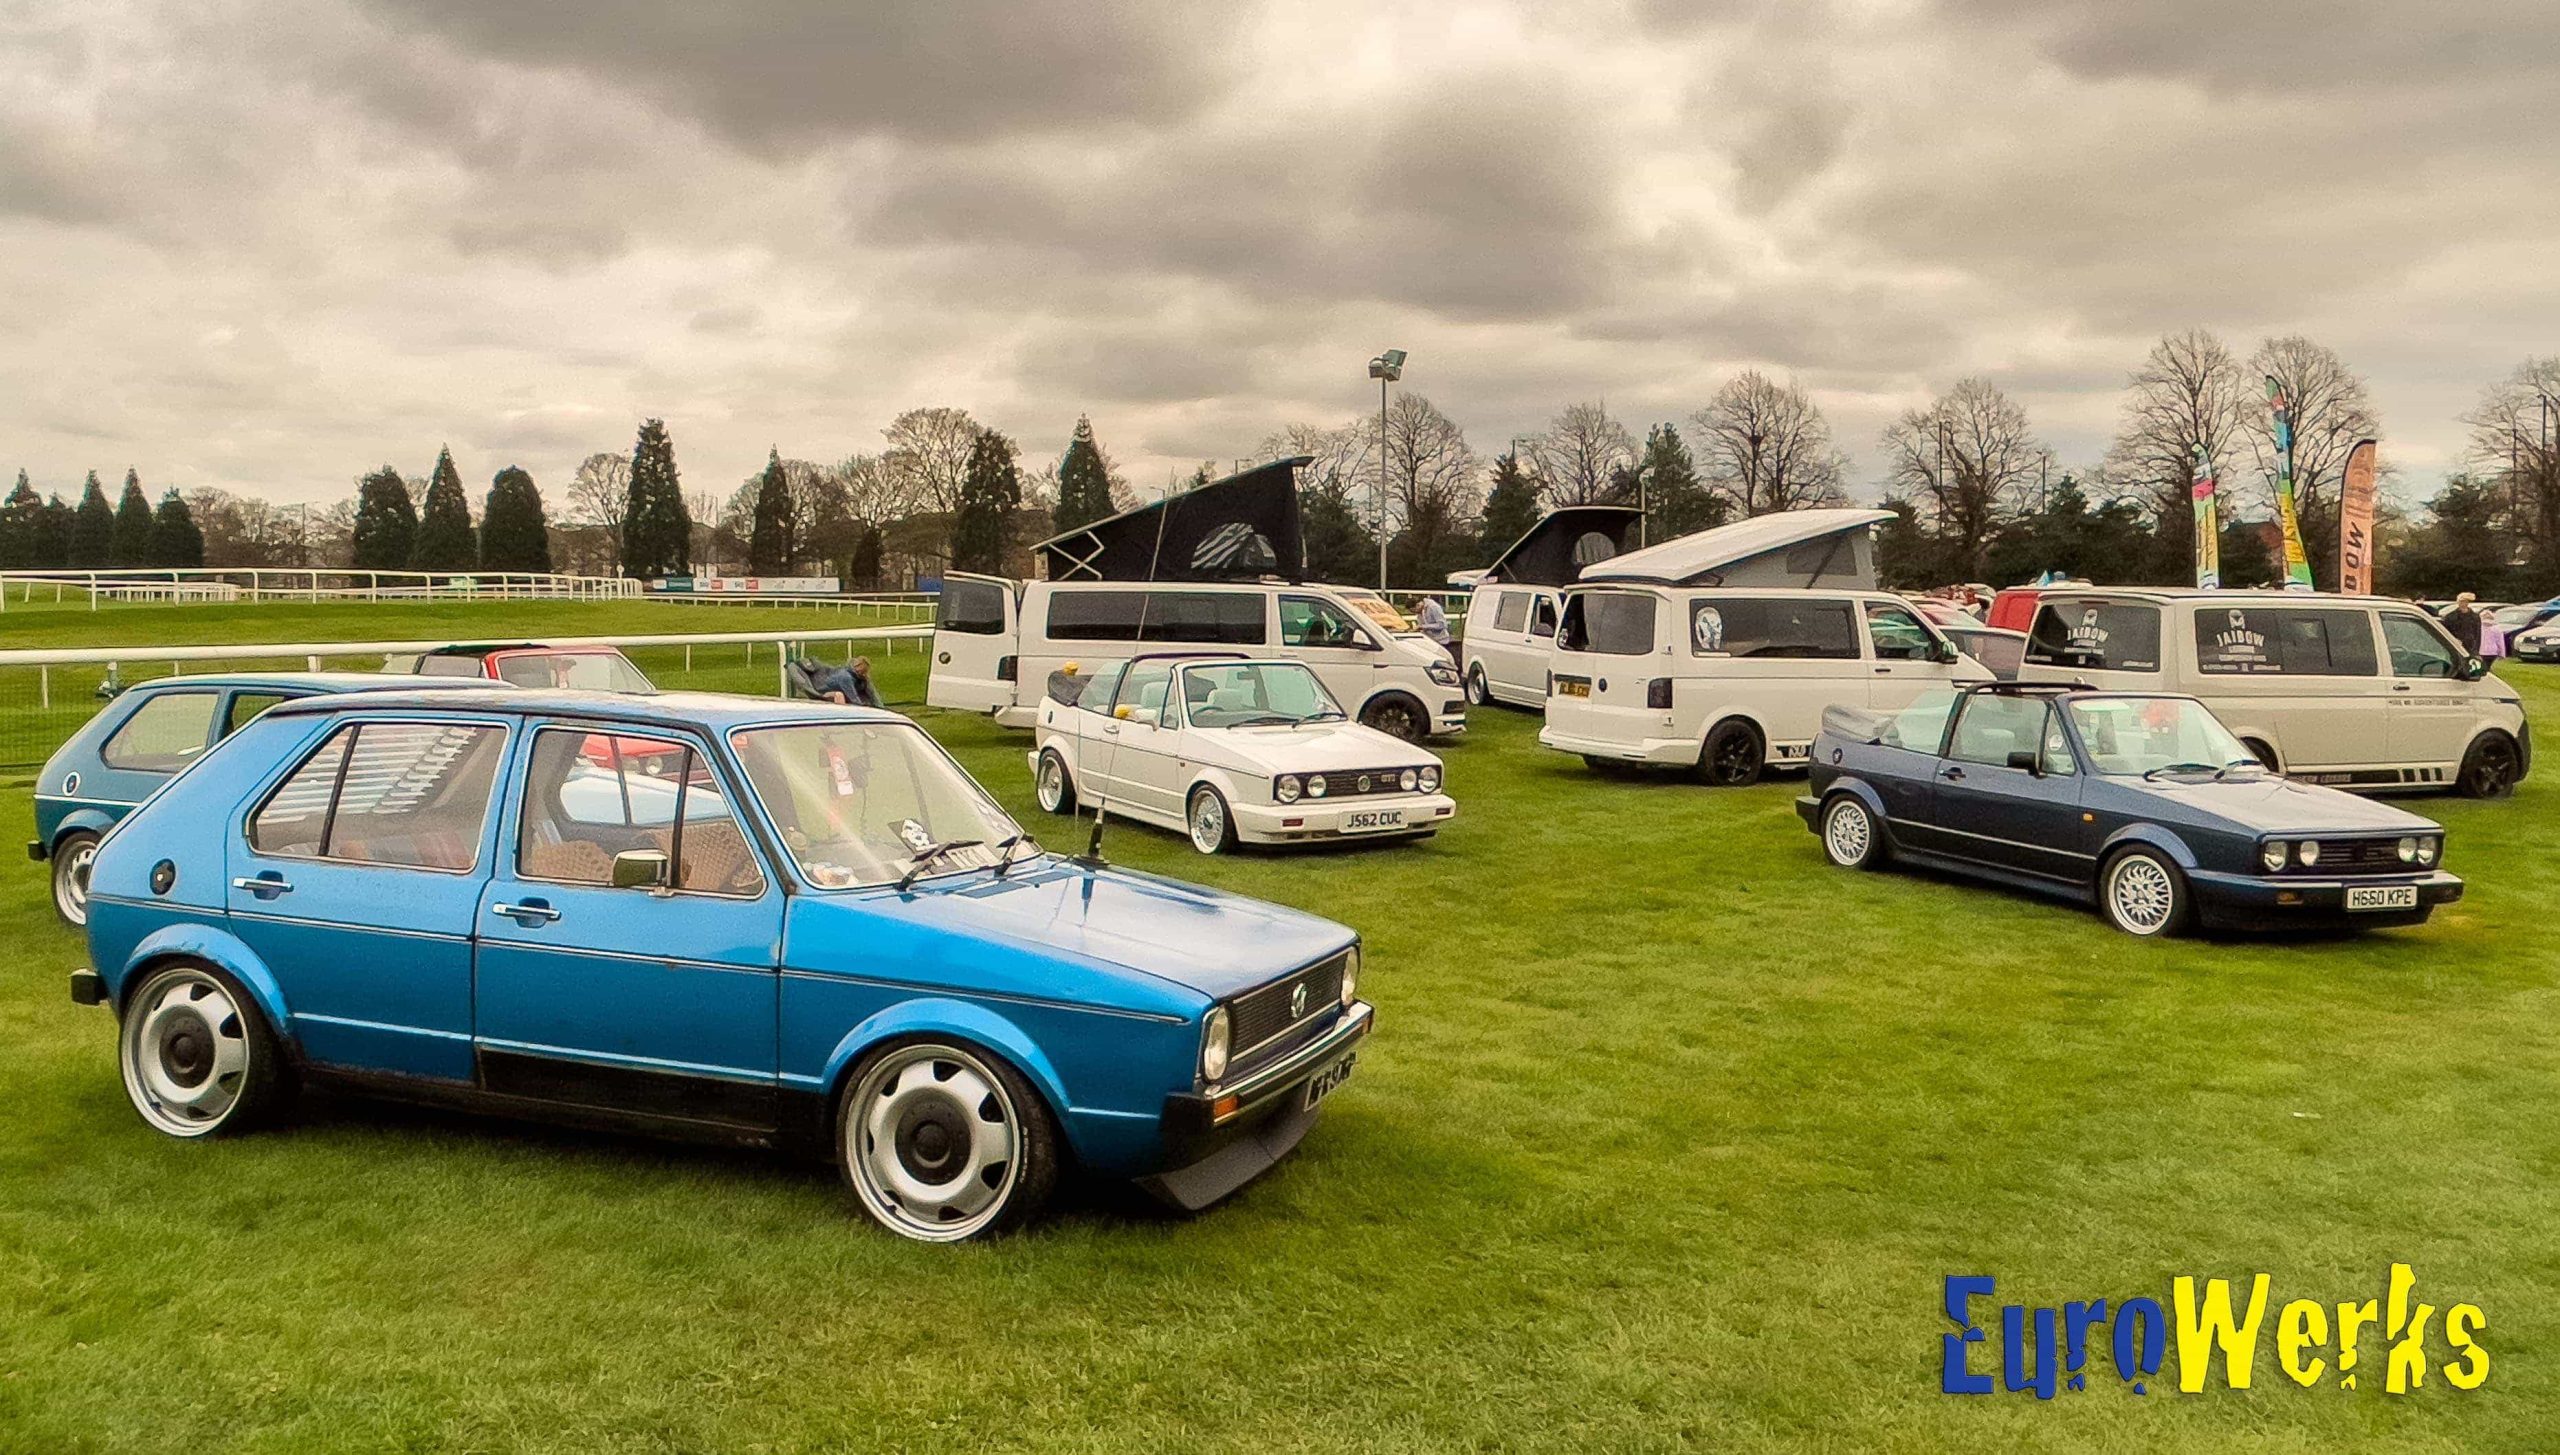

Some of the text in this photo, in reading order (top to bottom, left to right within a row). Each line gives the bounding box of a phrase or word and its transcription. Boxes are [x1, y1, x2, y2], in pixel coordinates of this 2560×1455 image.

[1347, 811, 1402, 828] J562 CUC
[2352, 889, 2412, 906] H650 KPE
